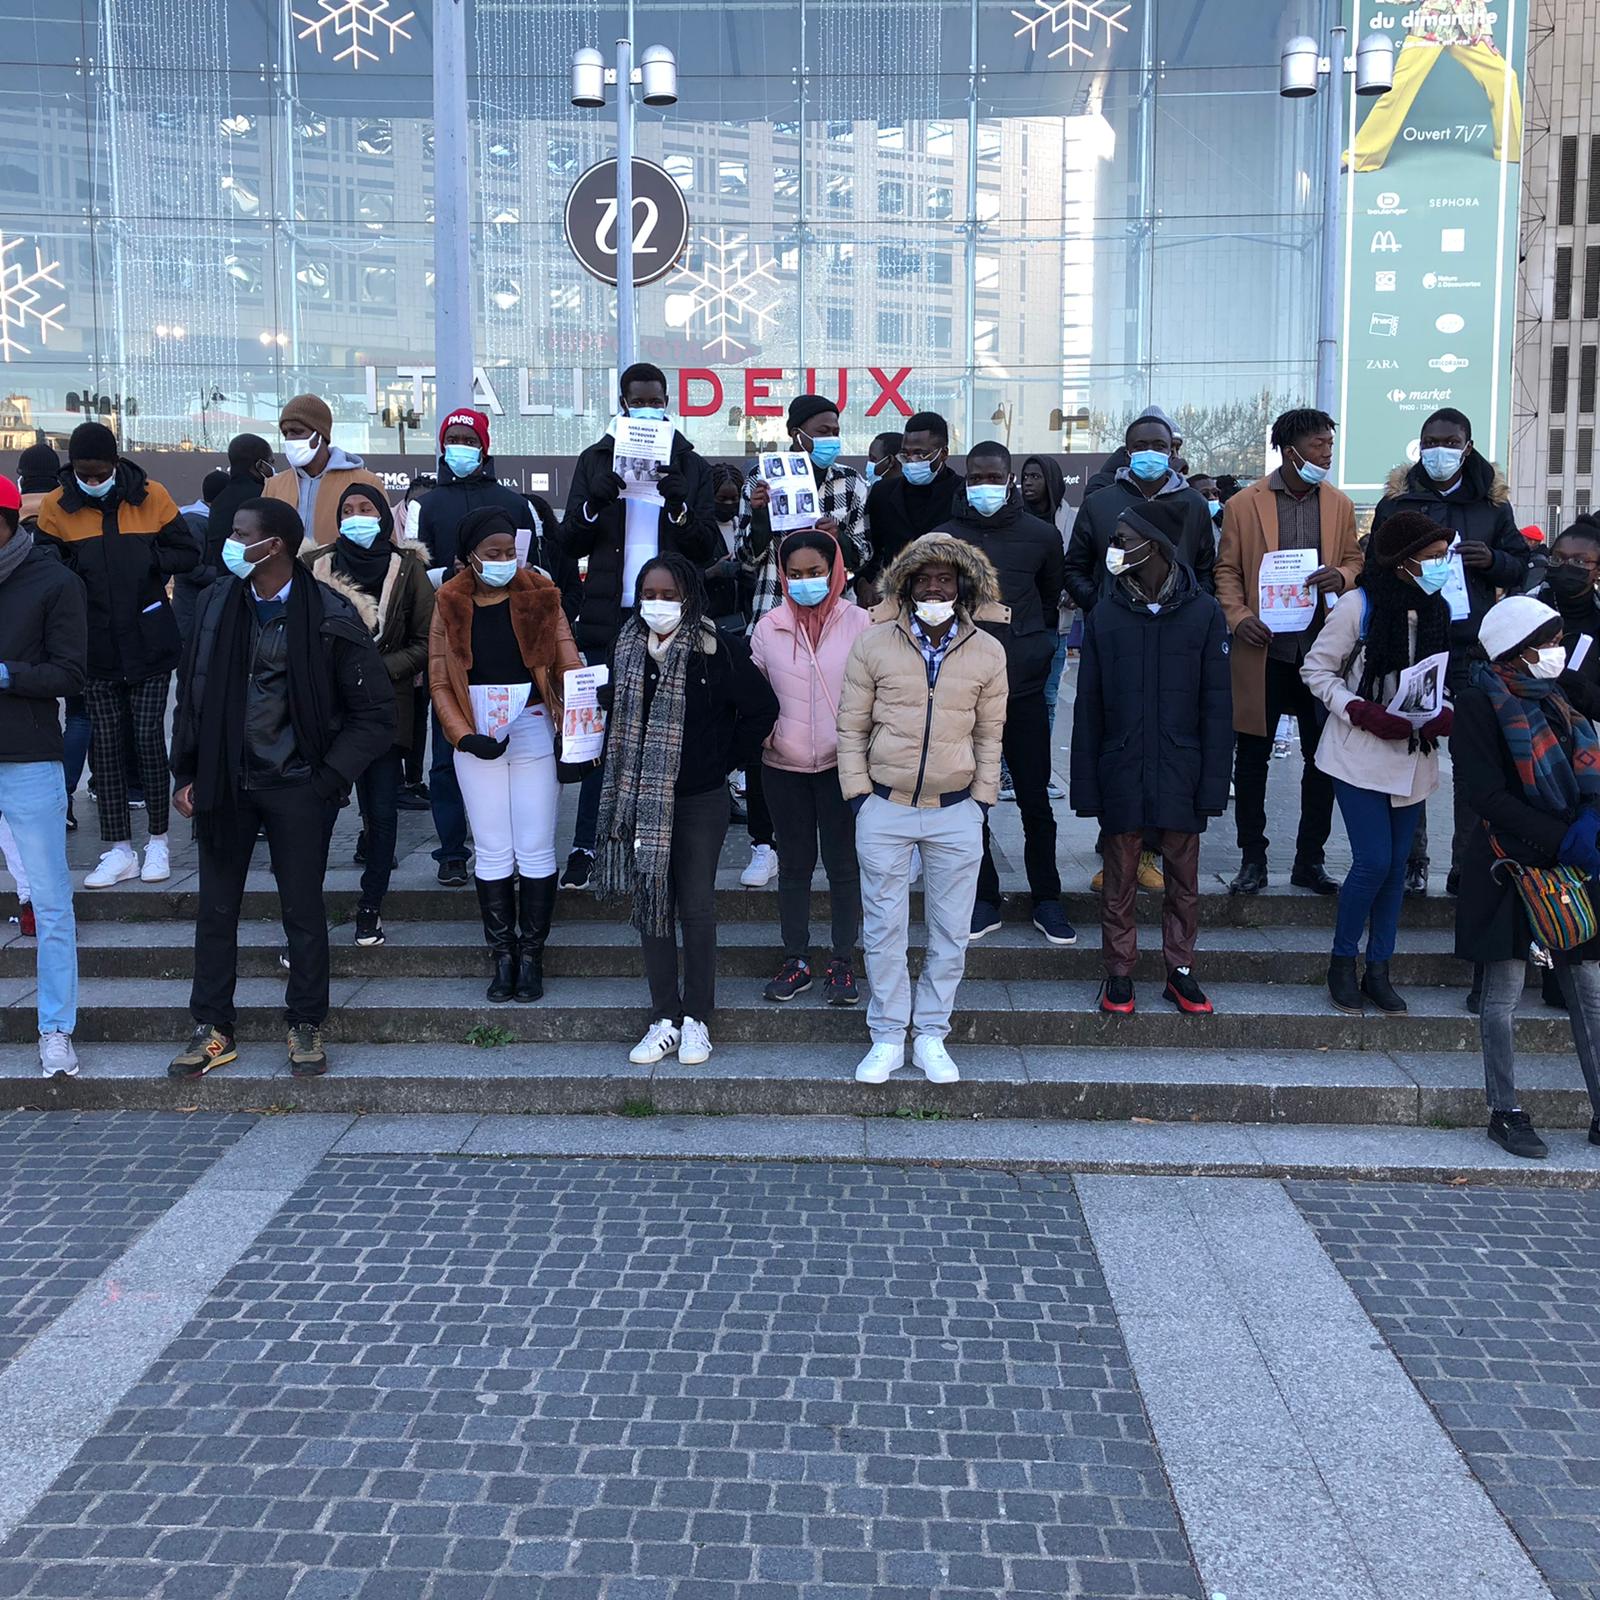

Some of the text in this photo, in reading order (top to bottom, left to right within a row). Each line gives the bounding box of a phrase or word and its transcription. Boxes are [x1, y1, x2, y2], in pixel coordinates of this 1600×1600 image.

[1369, 10, 1498, 29] du dimanche
[1403, 124, 1487, 143] Ouvert 7j/7
[1429, 198, 1480, 208] SEPHORA
[1366, 359, 1399, 369] ZARA
[678, 368, 915, 417] DEUX
[1409, 388, 1452, 401] market
[447, 414, 475, 426] PARIS
[496, 478, 519, 487] ARA
